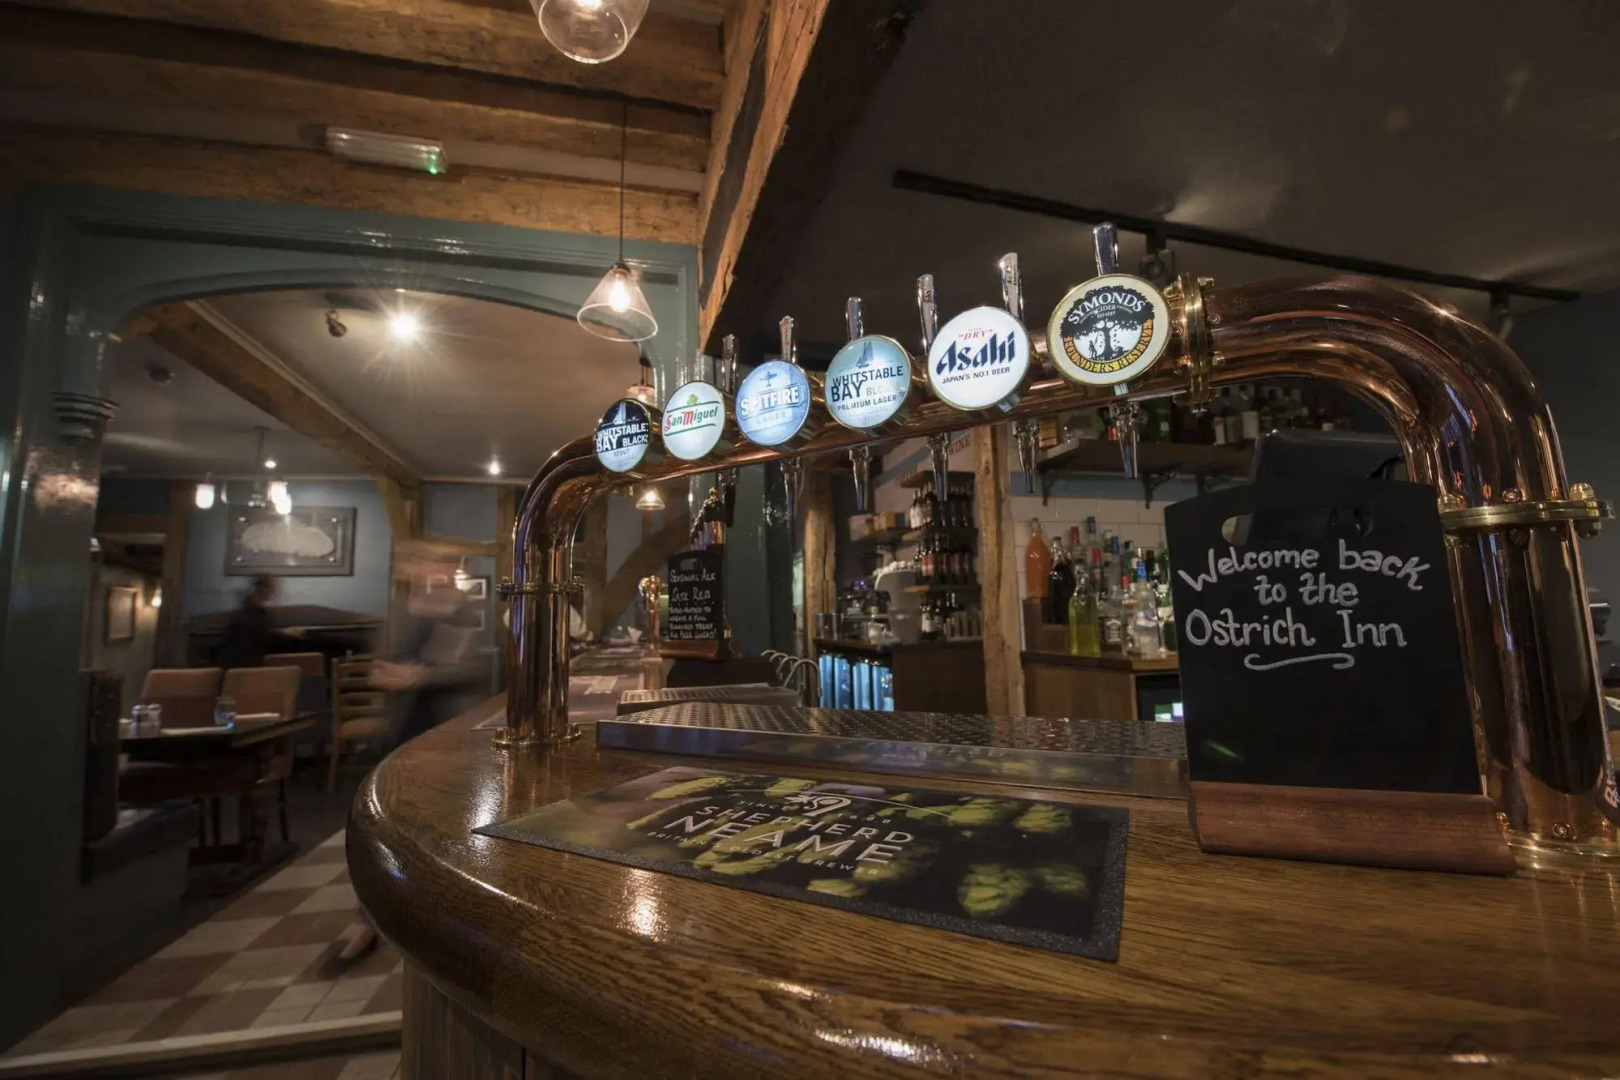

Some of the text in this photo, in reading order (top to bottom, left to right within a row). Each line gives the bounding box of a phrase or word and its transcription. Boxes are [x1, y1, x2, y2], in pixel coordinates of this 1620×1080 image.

[1068, 292, 1146, 324] SYMONDS
[936, 330, 1015, 375] Asahi
[831, 379, 902, 402] BAY BLOE
[832, 365, 904, 388] WHITSTABLE
[942, 367, 1010, 384] JAPAN'S NO.1 BEER
[837, 395, 897, 411] PREMIUM LAGER
[596, 433, 619, 453] BAY
[597, 423, 647, 442] WHITSTABLE
[1177, 538, 1432, 592] Welcome back
[1254, 572, 1359, 607] to the
[1185, 606, 1407, 649] Ostrich Inn
[662, 815, 904, 865] NEAME
[695, 806, 914, 844] SHEPHERD
[729, 845, 796, 861] OLDEST
[801, 857, 879, 875] BREWER
